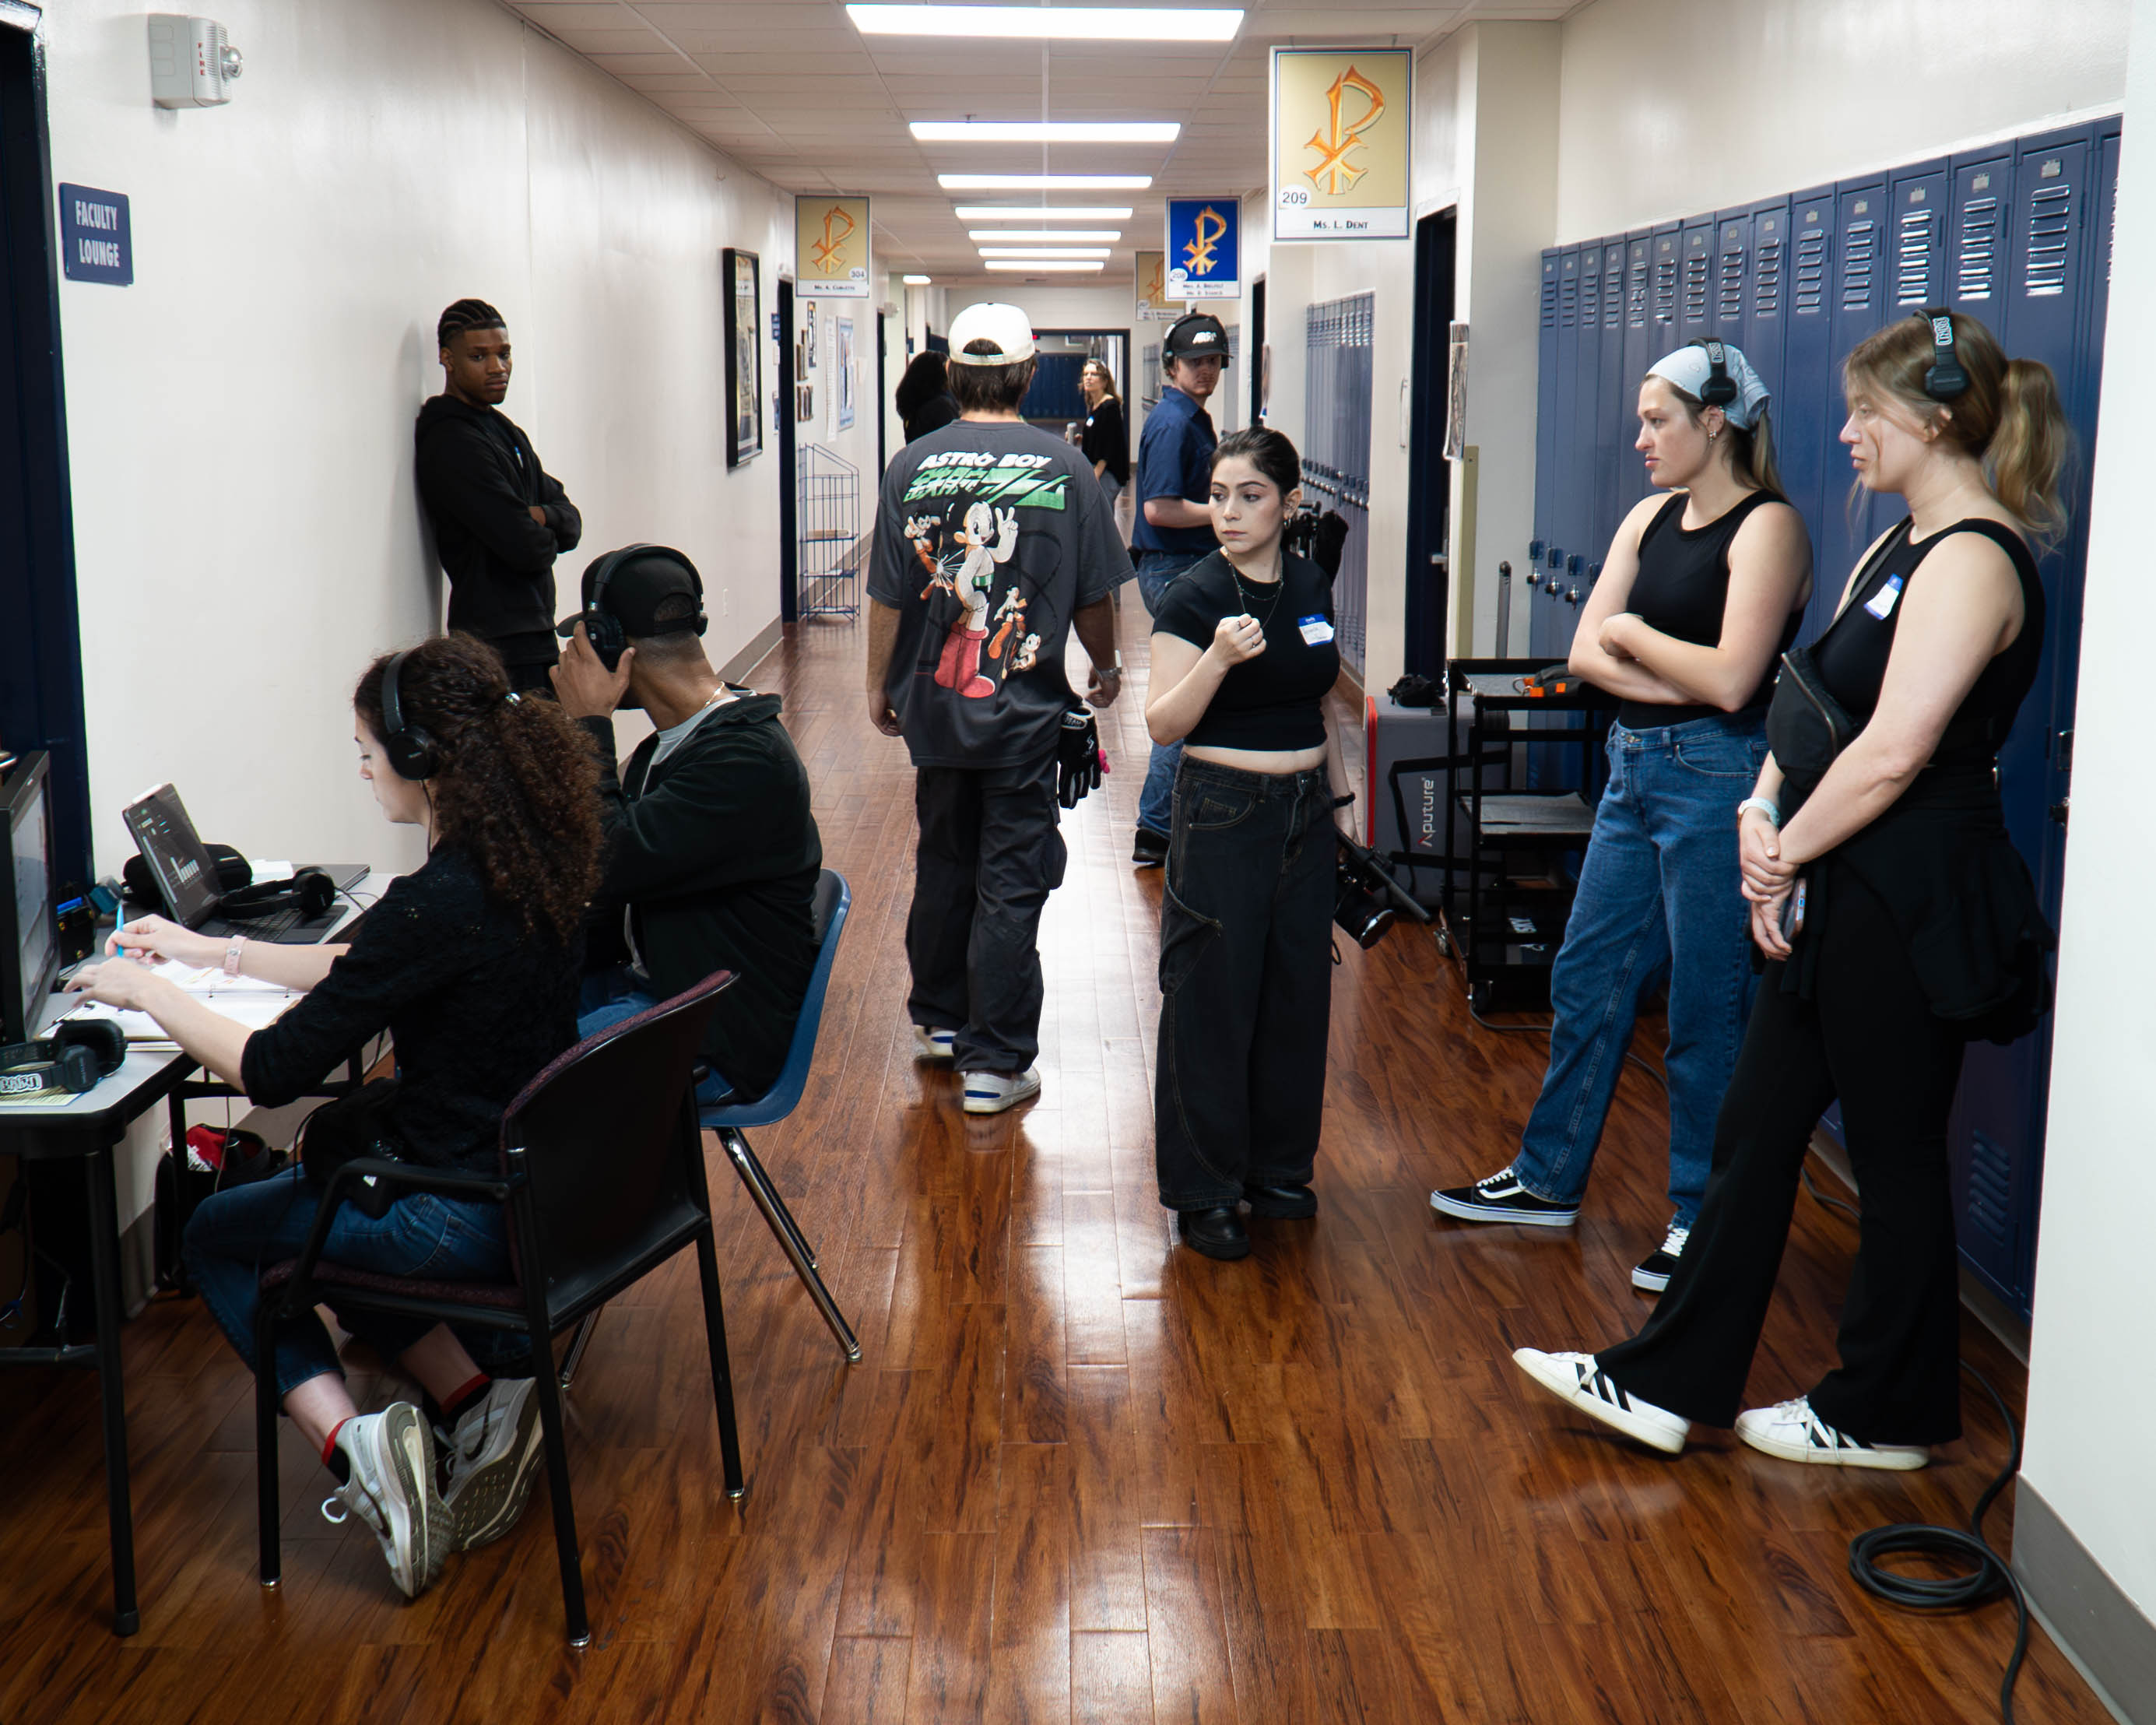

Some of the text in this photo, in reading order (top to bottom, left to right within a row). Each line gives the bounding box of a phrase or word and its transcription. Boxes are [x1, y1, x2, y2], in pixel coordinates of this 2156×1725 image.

[197, 42, 205, 76] FIRE
[1282, 191, 1308, 204] 209
[75, 200, 117, 230] FACULTY
[79, 238, 120, 267] LOUNGE
[917, 451, 1052, 471] ASTRO BOY
[1418, 778, 1437, 847] Aputure
